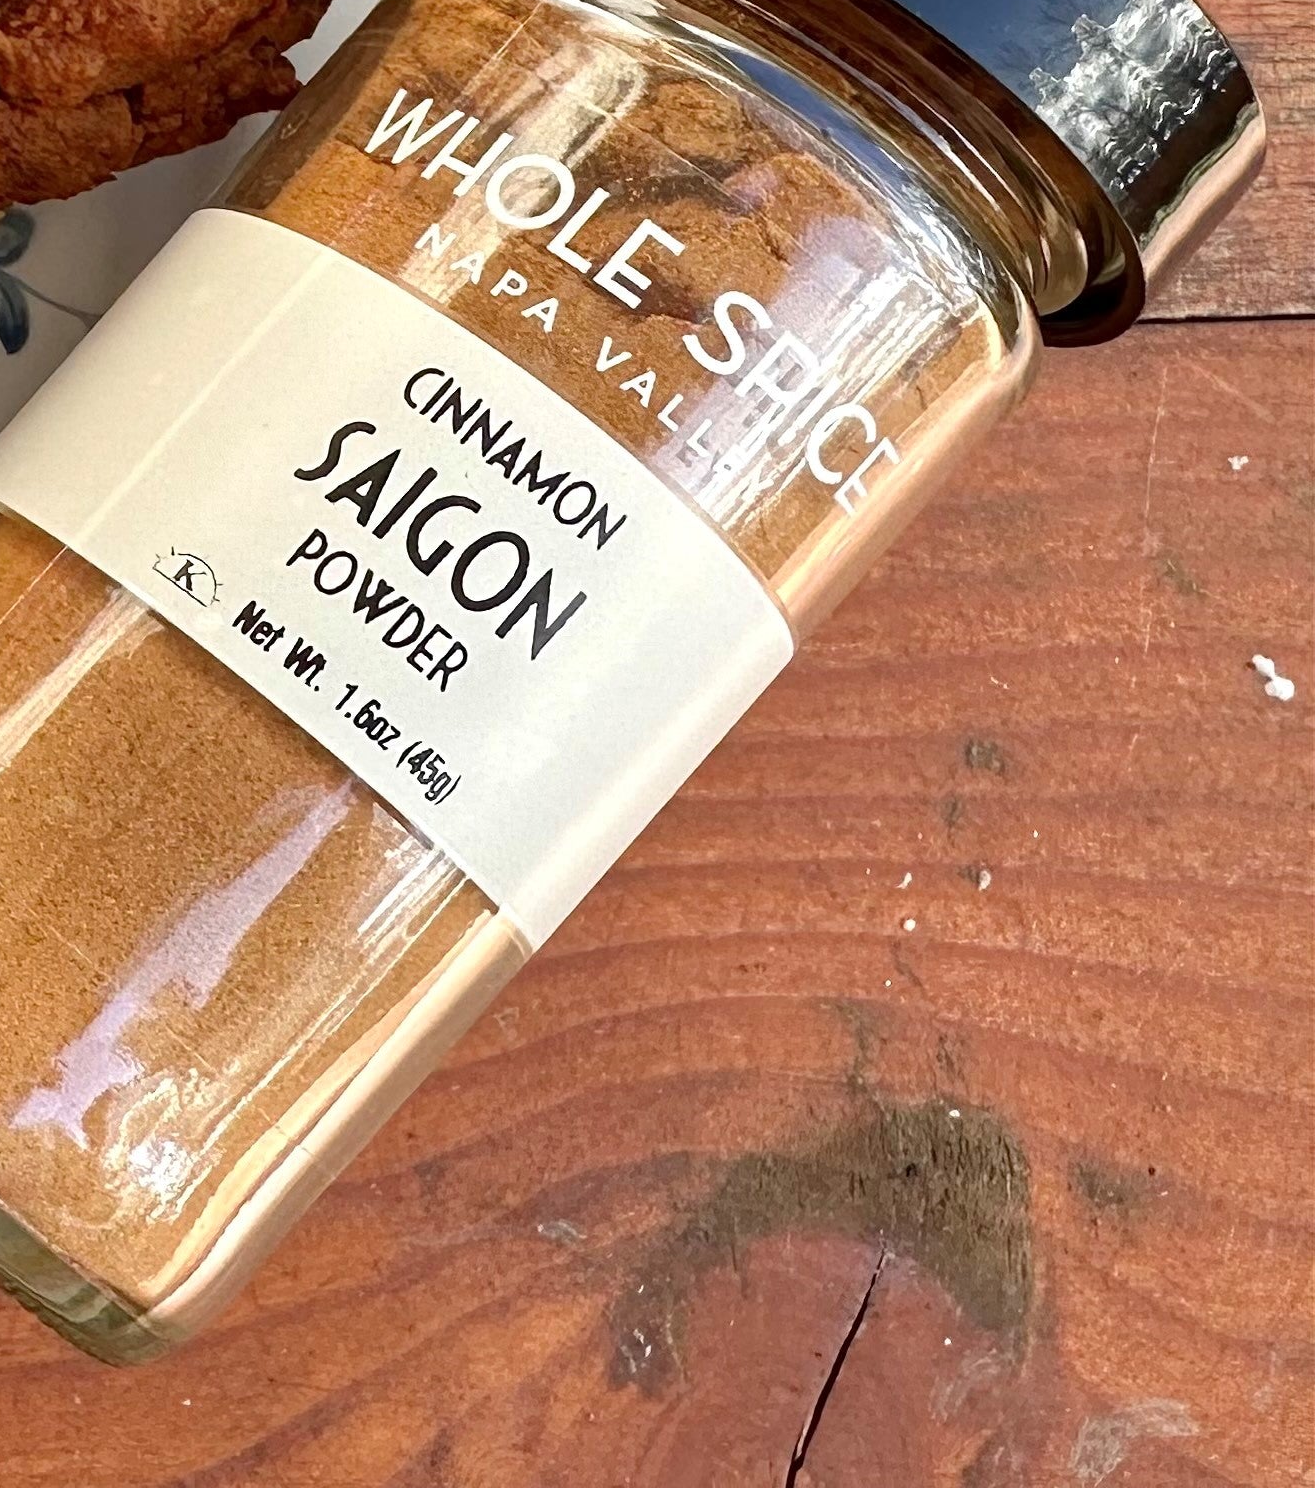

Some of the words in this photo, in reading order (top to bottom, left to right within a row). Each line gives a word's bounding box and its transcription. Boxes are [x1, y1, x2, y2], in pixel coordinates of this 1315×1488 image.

[364, 88, 685, 309] WHOLE
[682, 291, 901, 517] SPICE
[414, 223, 560, 332] NAPA
[595, 336, 774, 500] VALLY
[294, 421, 587, 660] SAIGON
[404, 368, 627, 550] CINNAMON
[232, 600, 285, 653] Net
[283, 637, 327, 691] Wt.
[335, 683, 401, 751] 1.6oz
[396, 740, 463, 806] (45g)
[287, 529, 468, 692] POWDER
